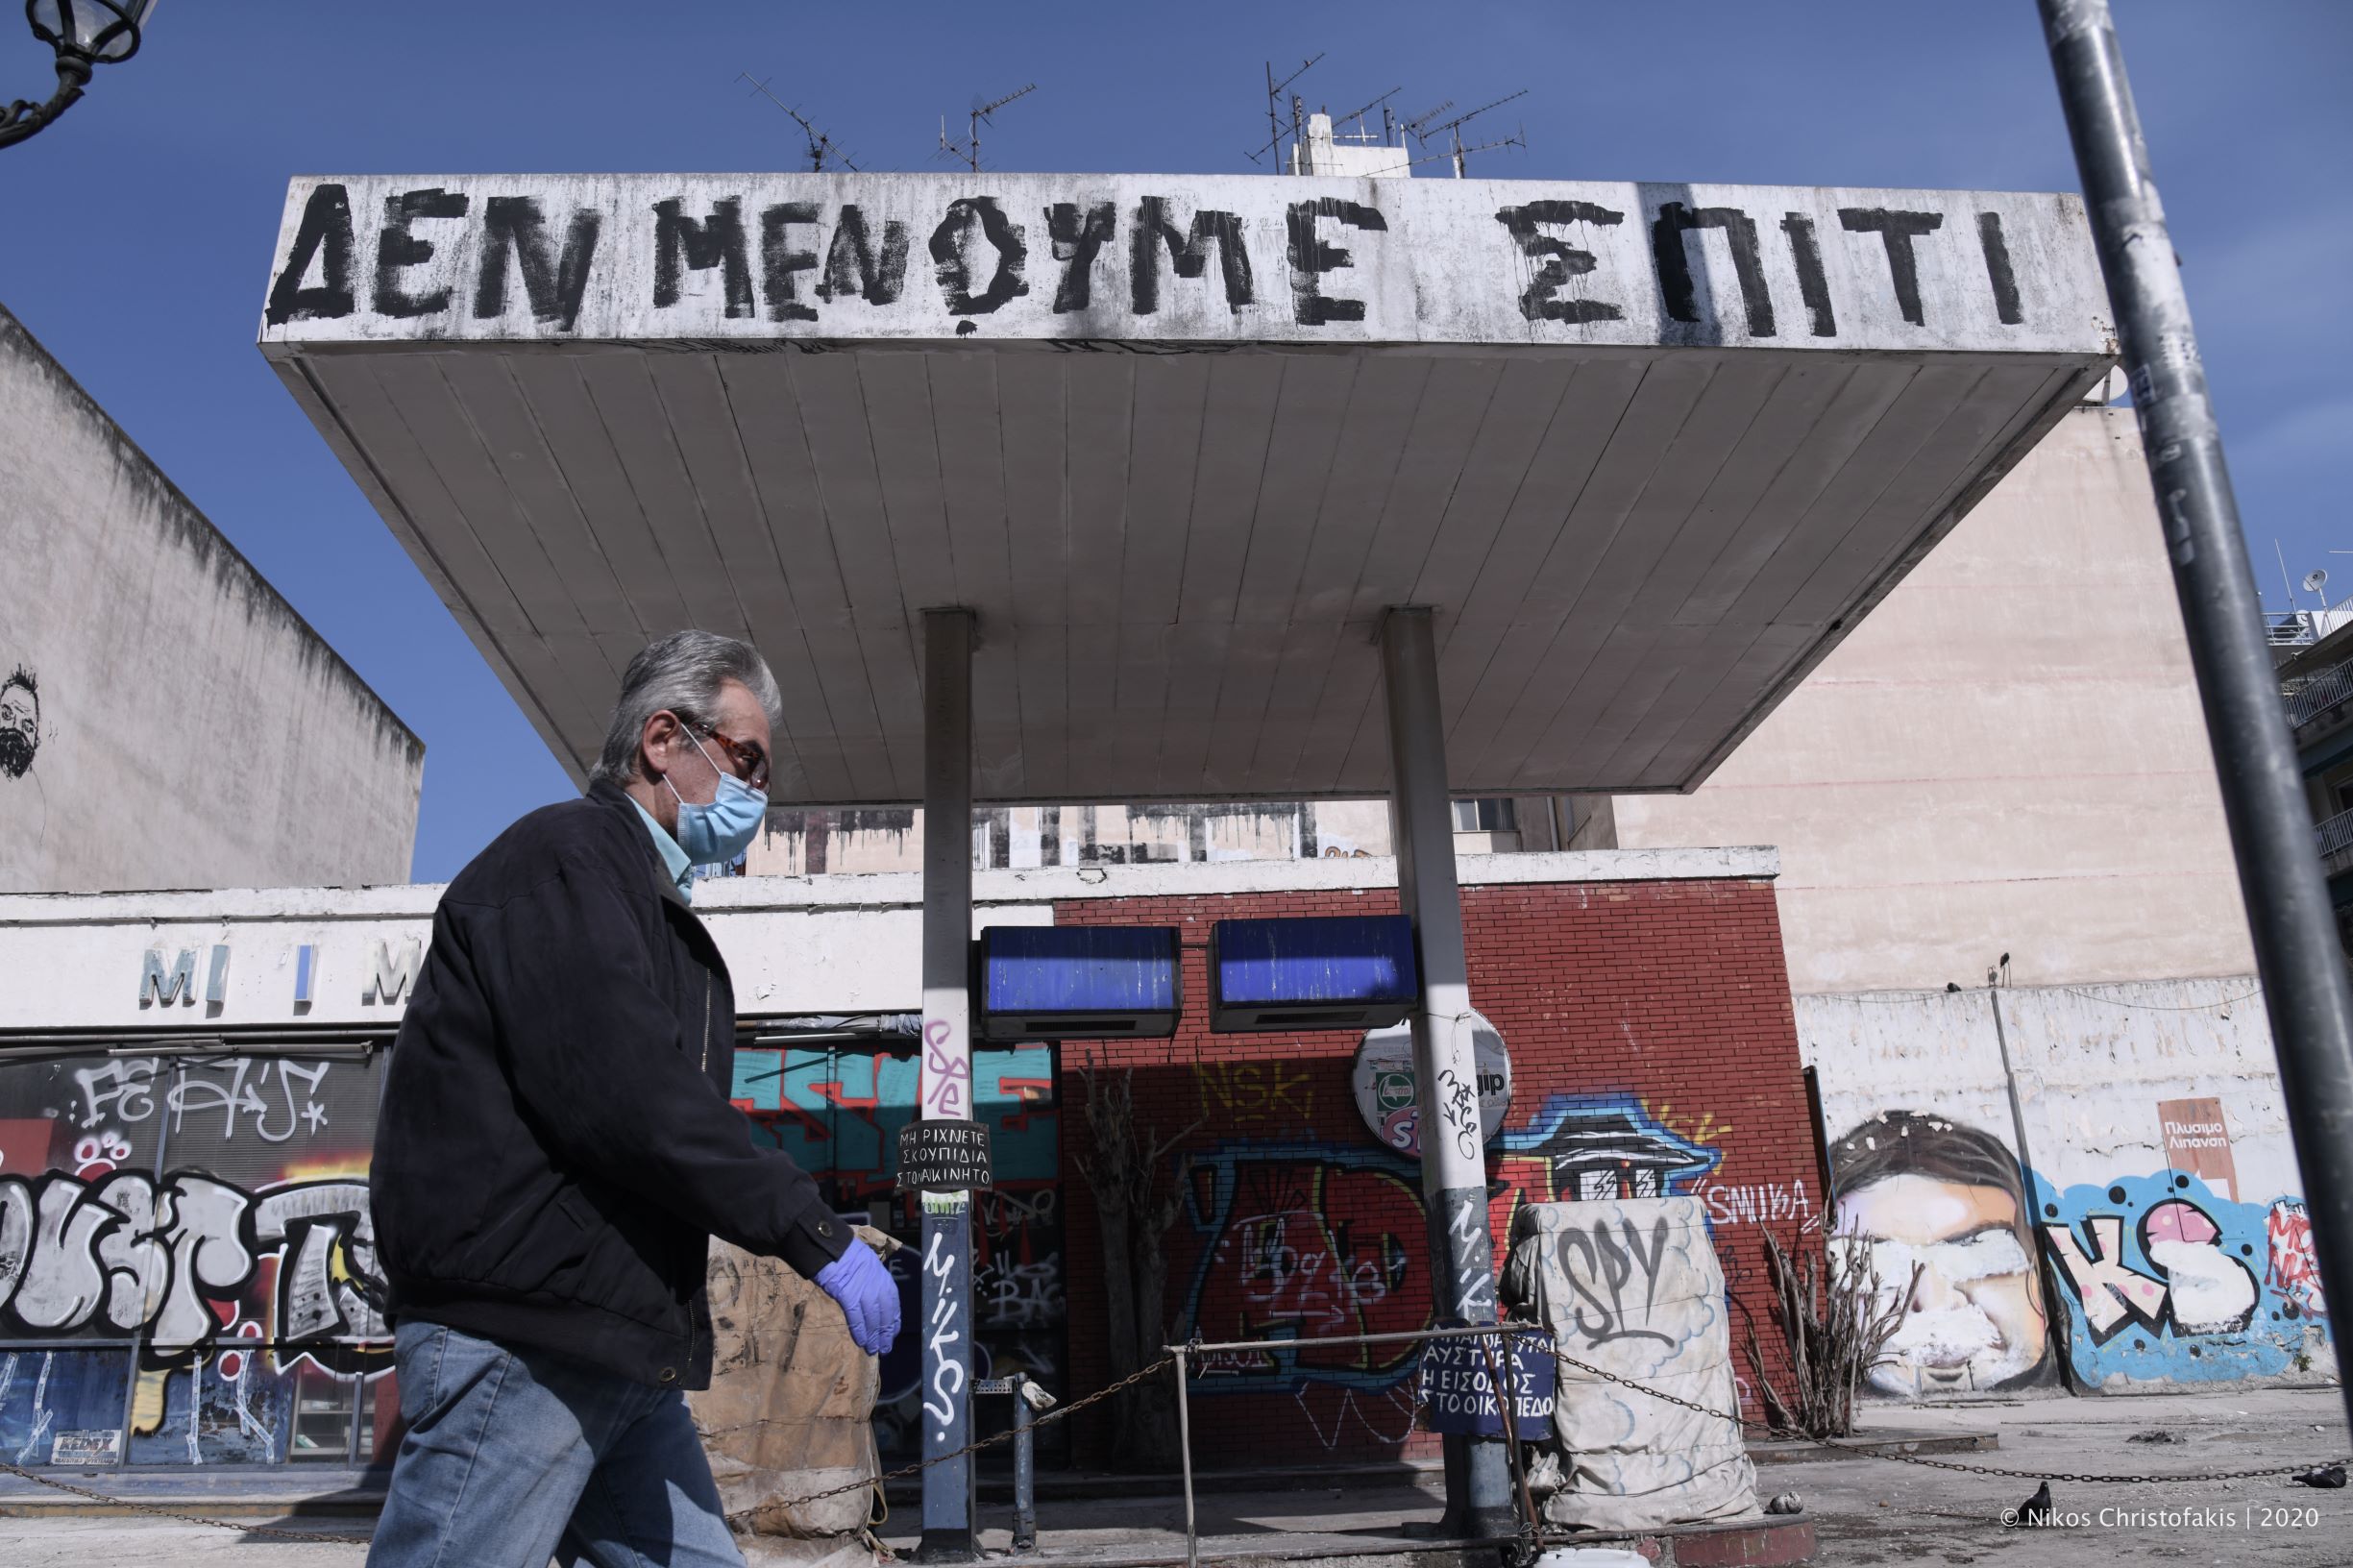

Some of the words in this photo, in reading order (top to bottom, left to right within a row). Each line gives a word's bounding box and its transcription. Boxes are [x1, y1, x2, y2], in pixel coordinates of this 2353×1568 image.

[265, 184, 599, 331] ΔΕΝ
[653, 194, 1387, 329] ΜΕΝΟΥΜΕ
[1494, 198, 2022, 337] ΣΠΙΤΙ
[899, 1130, 917, 1147] ΜΗ
[923, 1128, 985, 1147] ΡΙΧΝΕΤΕ
[903, 1147, 988, 1164] ΣΚΟΥΠΙΔΙΑ
